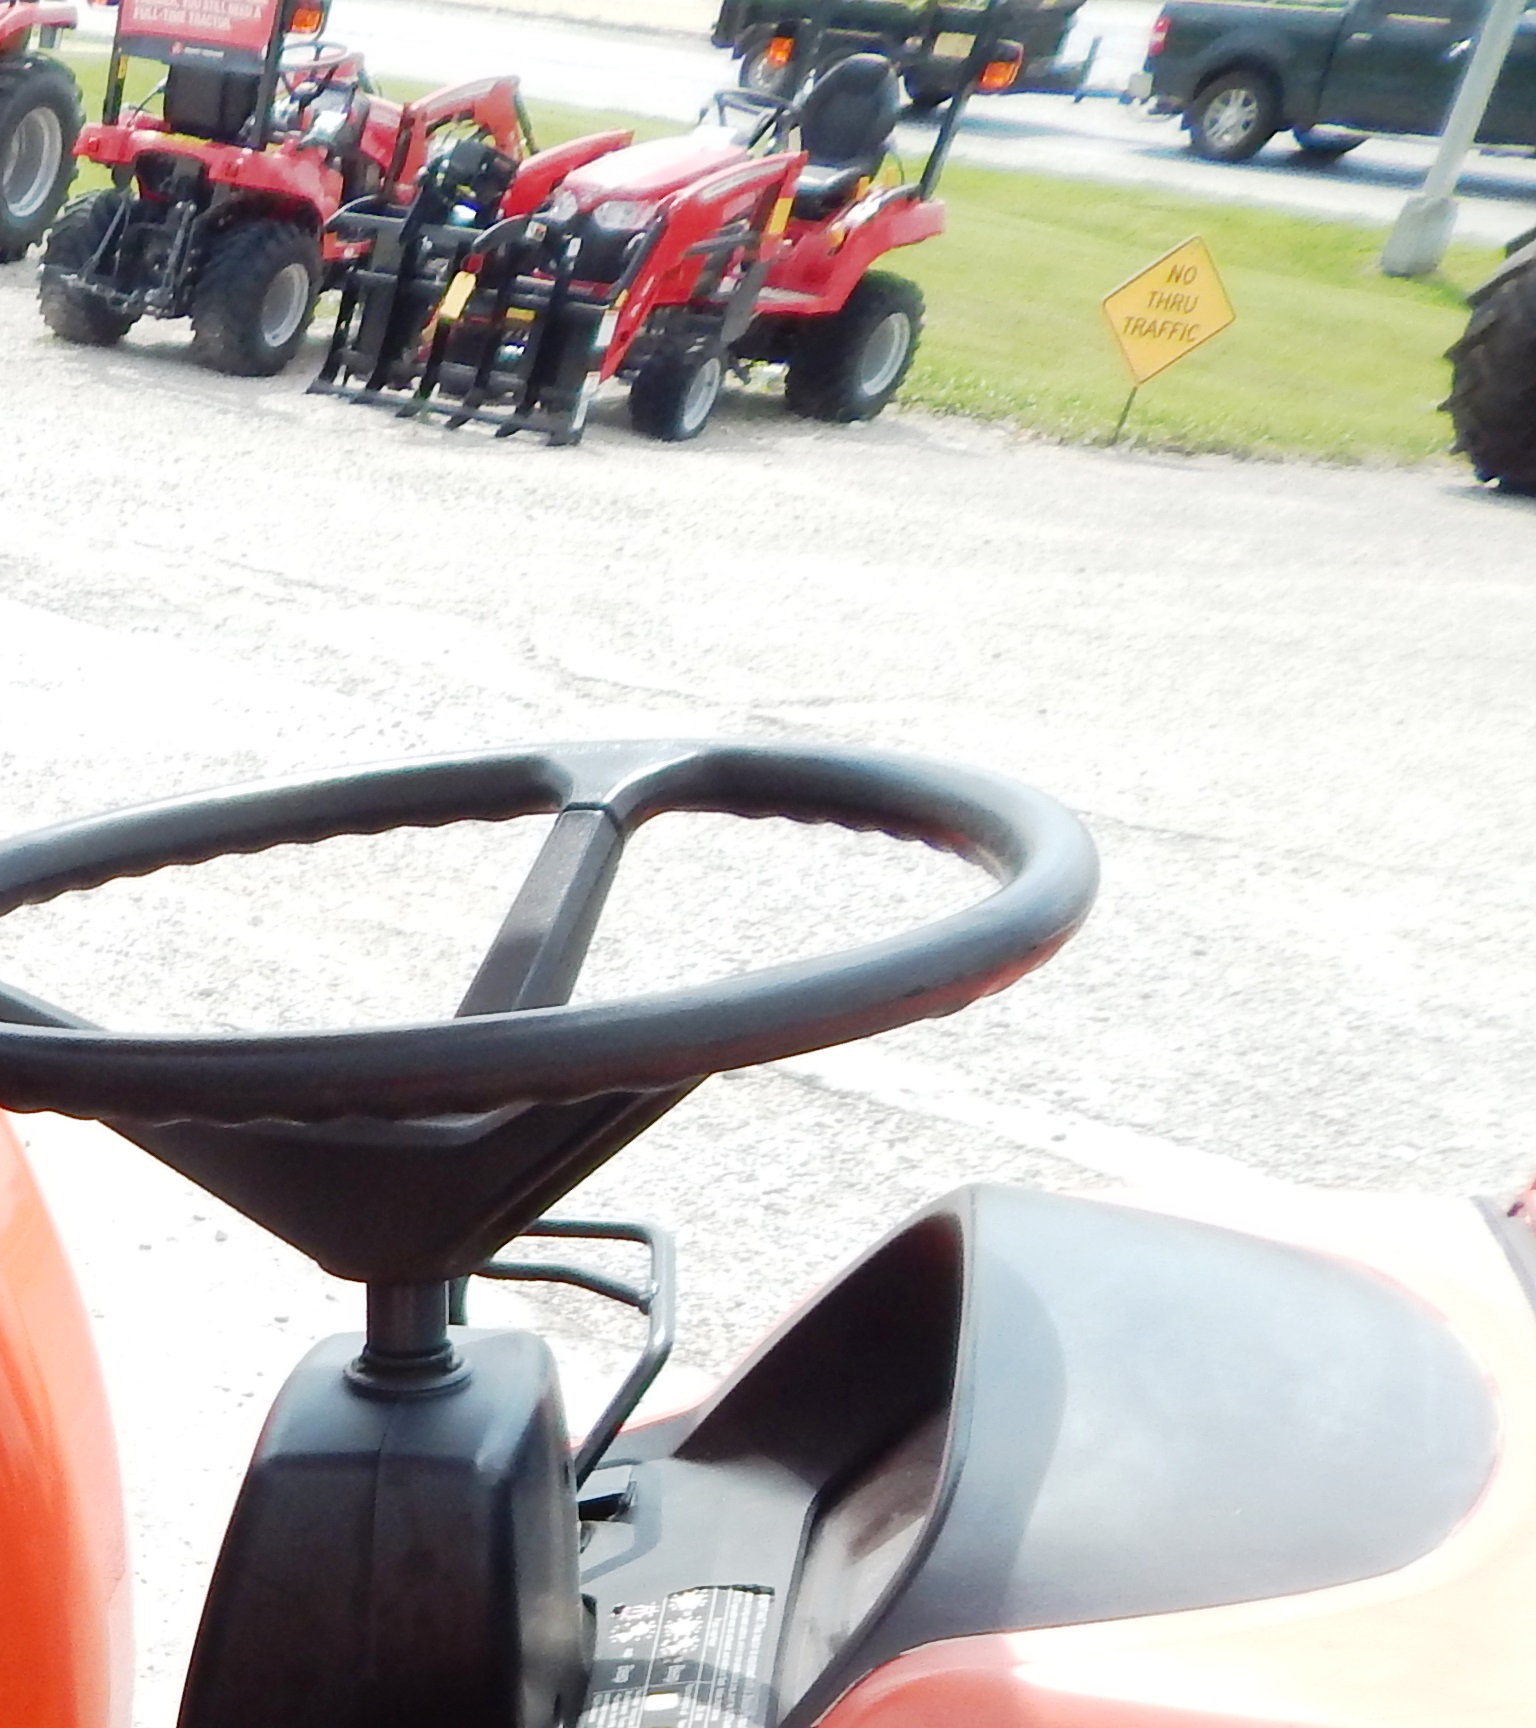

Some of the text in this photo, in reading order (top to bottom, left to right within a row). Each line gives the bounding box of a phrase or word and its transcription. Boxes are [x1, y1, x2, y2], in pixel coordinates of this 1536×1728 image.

[1166, 264, 1198, 285] NO
[1146, 290, 1200, 314] THRU
[1122, 316, 1200, 343] TRAFFIC
